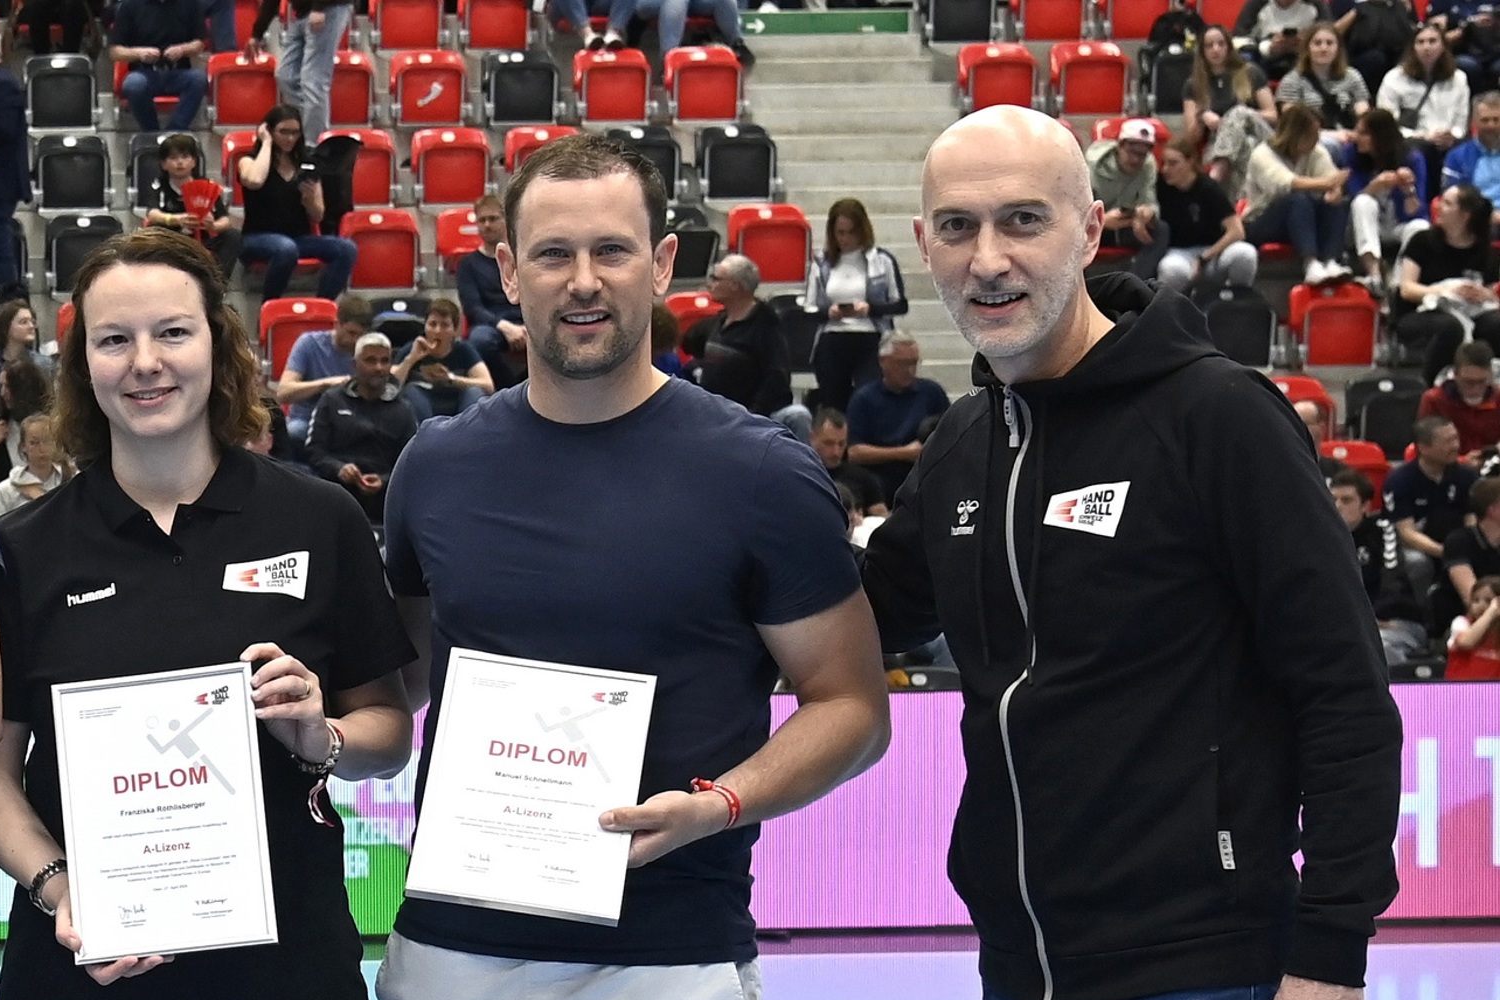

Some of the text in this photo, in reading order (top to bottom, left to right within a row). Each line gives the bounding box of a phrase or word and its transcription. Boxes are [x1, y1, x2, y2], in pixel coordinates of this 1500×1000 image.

[1081, 489, 1115, 505] HAND
[1084, 503, 1112, 516] BALL
[265, 557, 297, 573] HAND
[271, 568, 298, 580] BALL
[66, 582, 117, 608] hummel
[488, 740, 588, 768] DIPLOM
[113, 765, 208, 794] DIPLOM
[495, 771, 573, 786] Manuel Schnellmann
[120, 808, 155, 817] Franziska
[503, 804, 553, 820] A-Lizenz
[142, 840, 191, 855] A-Lizenz
